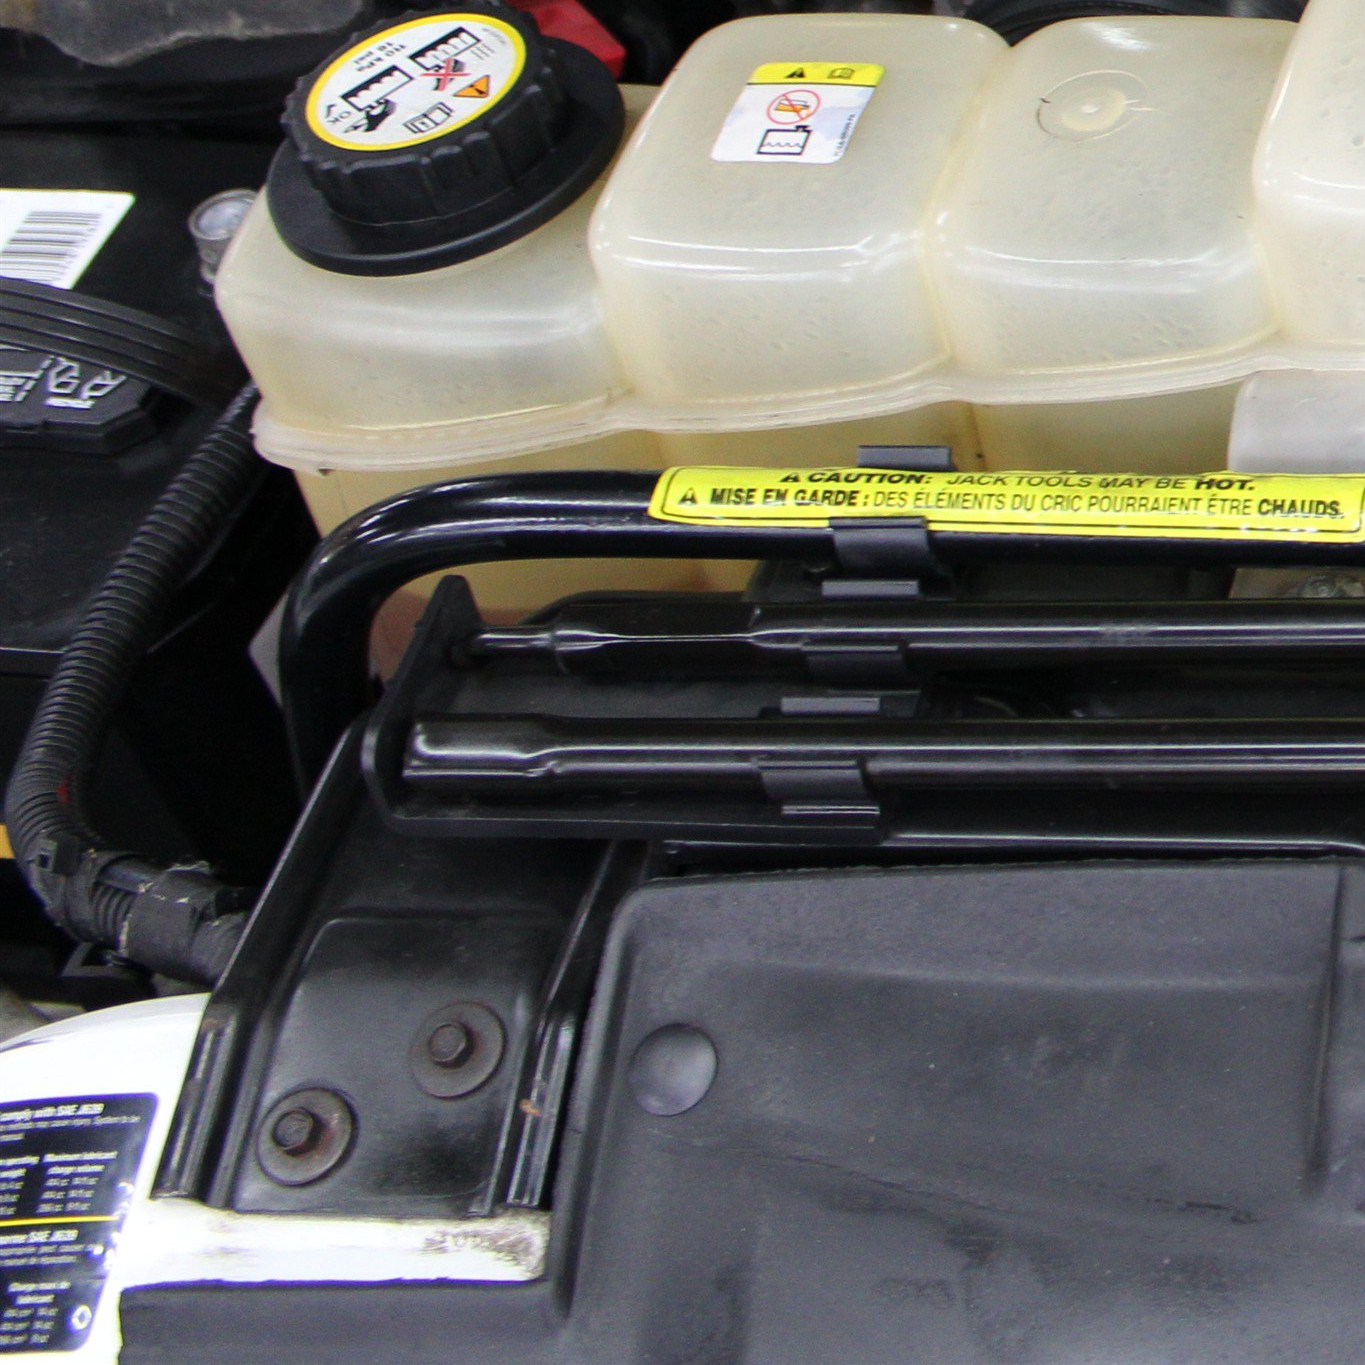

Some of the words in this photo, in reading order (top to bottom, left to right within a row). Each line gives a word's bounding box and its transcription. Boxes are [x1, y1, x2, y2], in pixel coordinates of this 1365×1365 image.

[329, 111, 352, 124] OK
[808, 472, 932, 485] CAUTION:
[946, 474, 1007, 487] JACK
[1012, 476, 1093, 488] TOOLS
[1099, 476, 1151, 489] MAY
[1154, 477, 1186, 490] BE
[1195, 477, 1256, 491] HOT.
[709, 488, 757, 506] MISE
[762, 488, 787, 506] EN
[794, 488, 858, 507] GARDE
[873, 491, 909, 508] DES
[913, 488, 1006, 511] ÉLÉMENTS
[1011, 493, 1035, 512] DU
[1040, 494, 1082, 513] CRIC
[1087, 494, 1202, 514] POURRAIENT
[1207, 493, 1252, 515] ÊTRE
[1257, 497, 1345, 520] CHAUDS.
[57, 1104, 79, 1117] SAE
